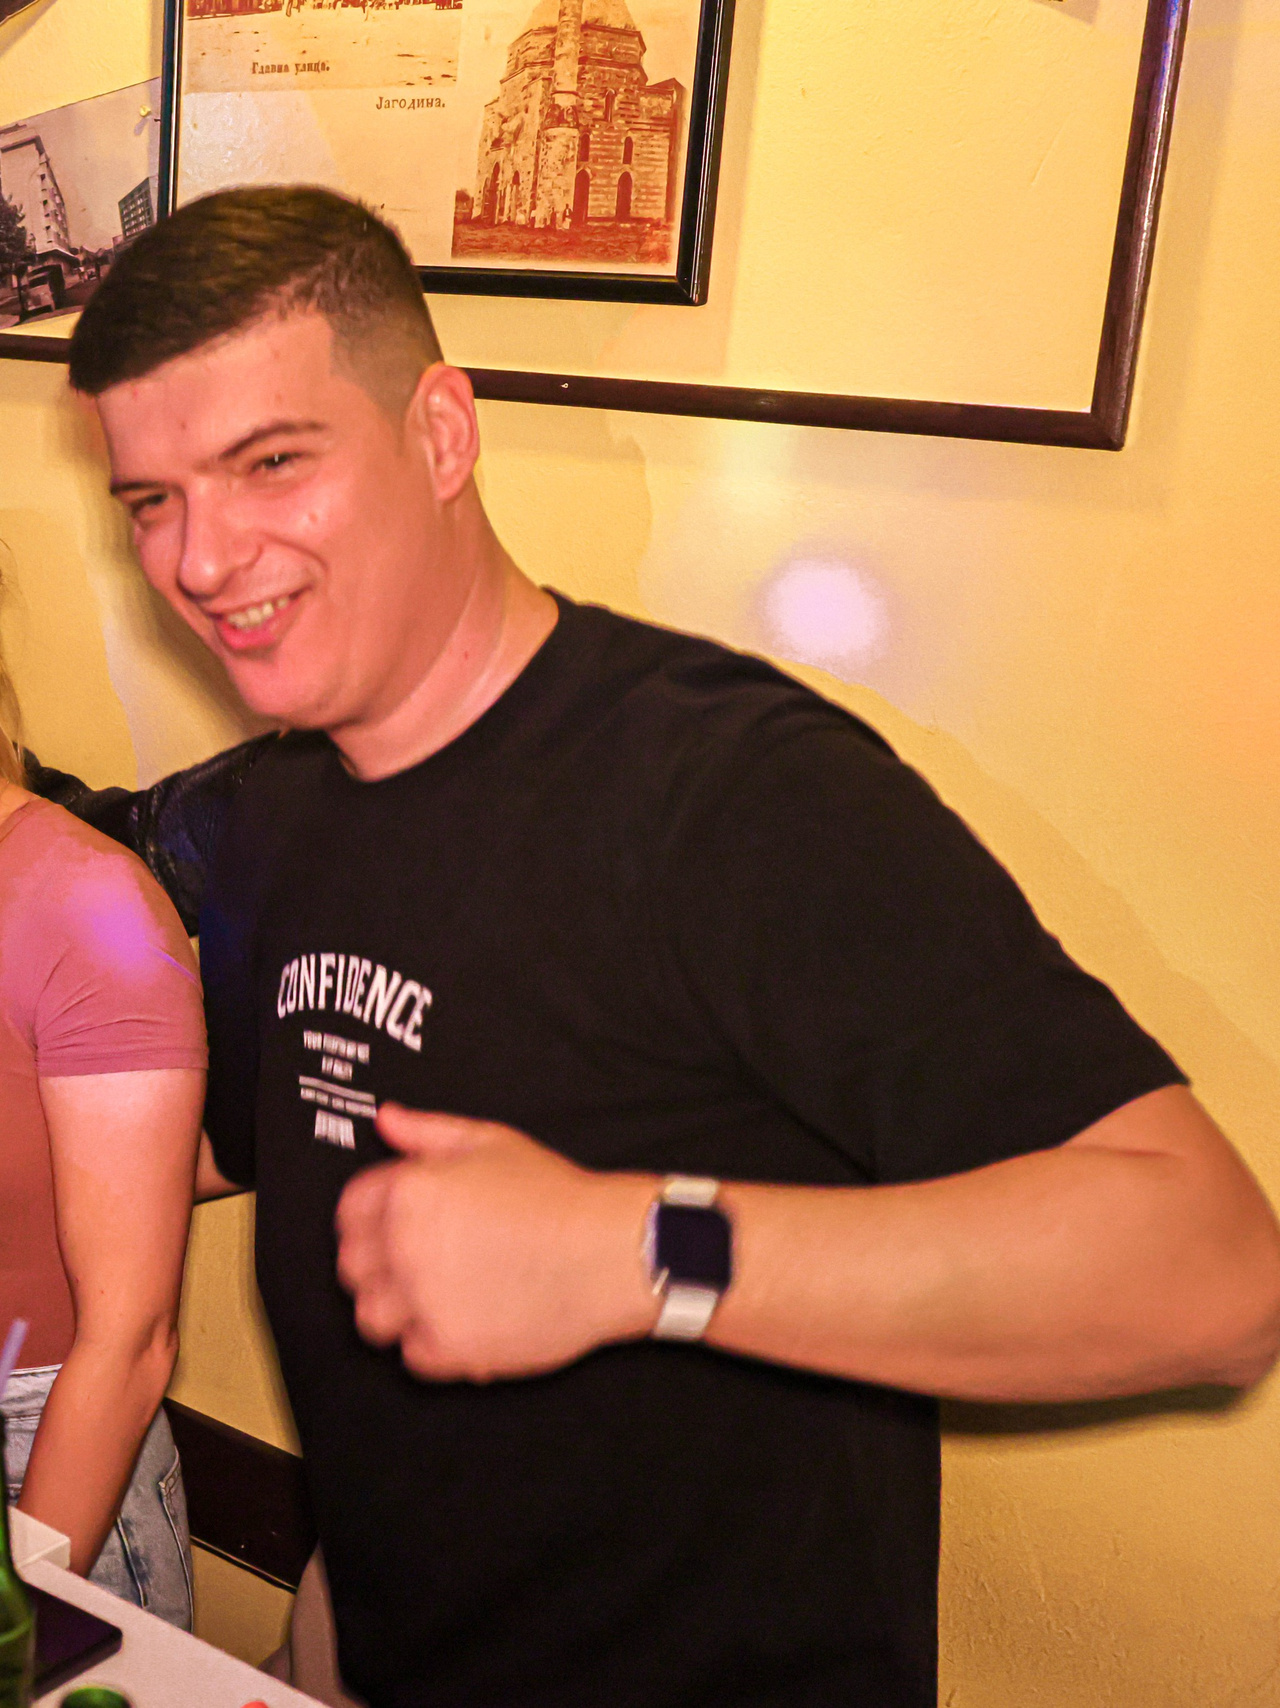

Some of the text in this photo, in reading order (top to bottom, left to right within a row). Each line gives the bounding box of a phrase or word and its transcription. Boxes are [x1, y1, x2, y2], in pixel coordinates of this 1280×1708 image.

[251, 60, 331, 76] Главна улица.
[375, 96, 446, 110] Јагодина.
[277, 953, 432, 1051] CONFIDENCE
